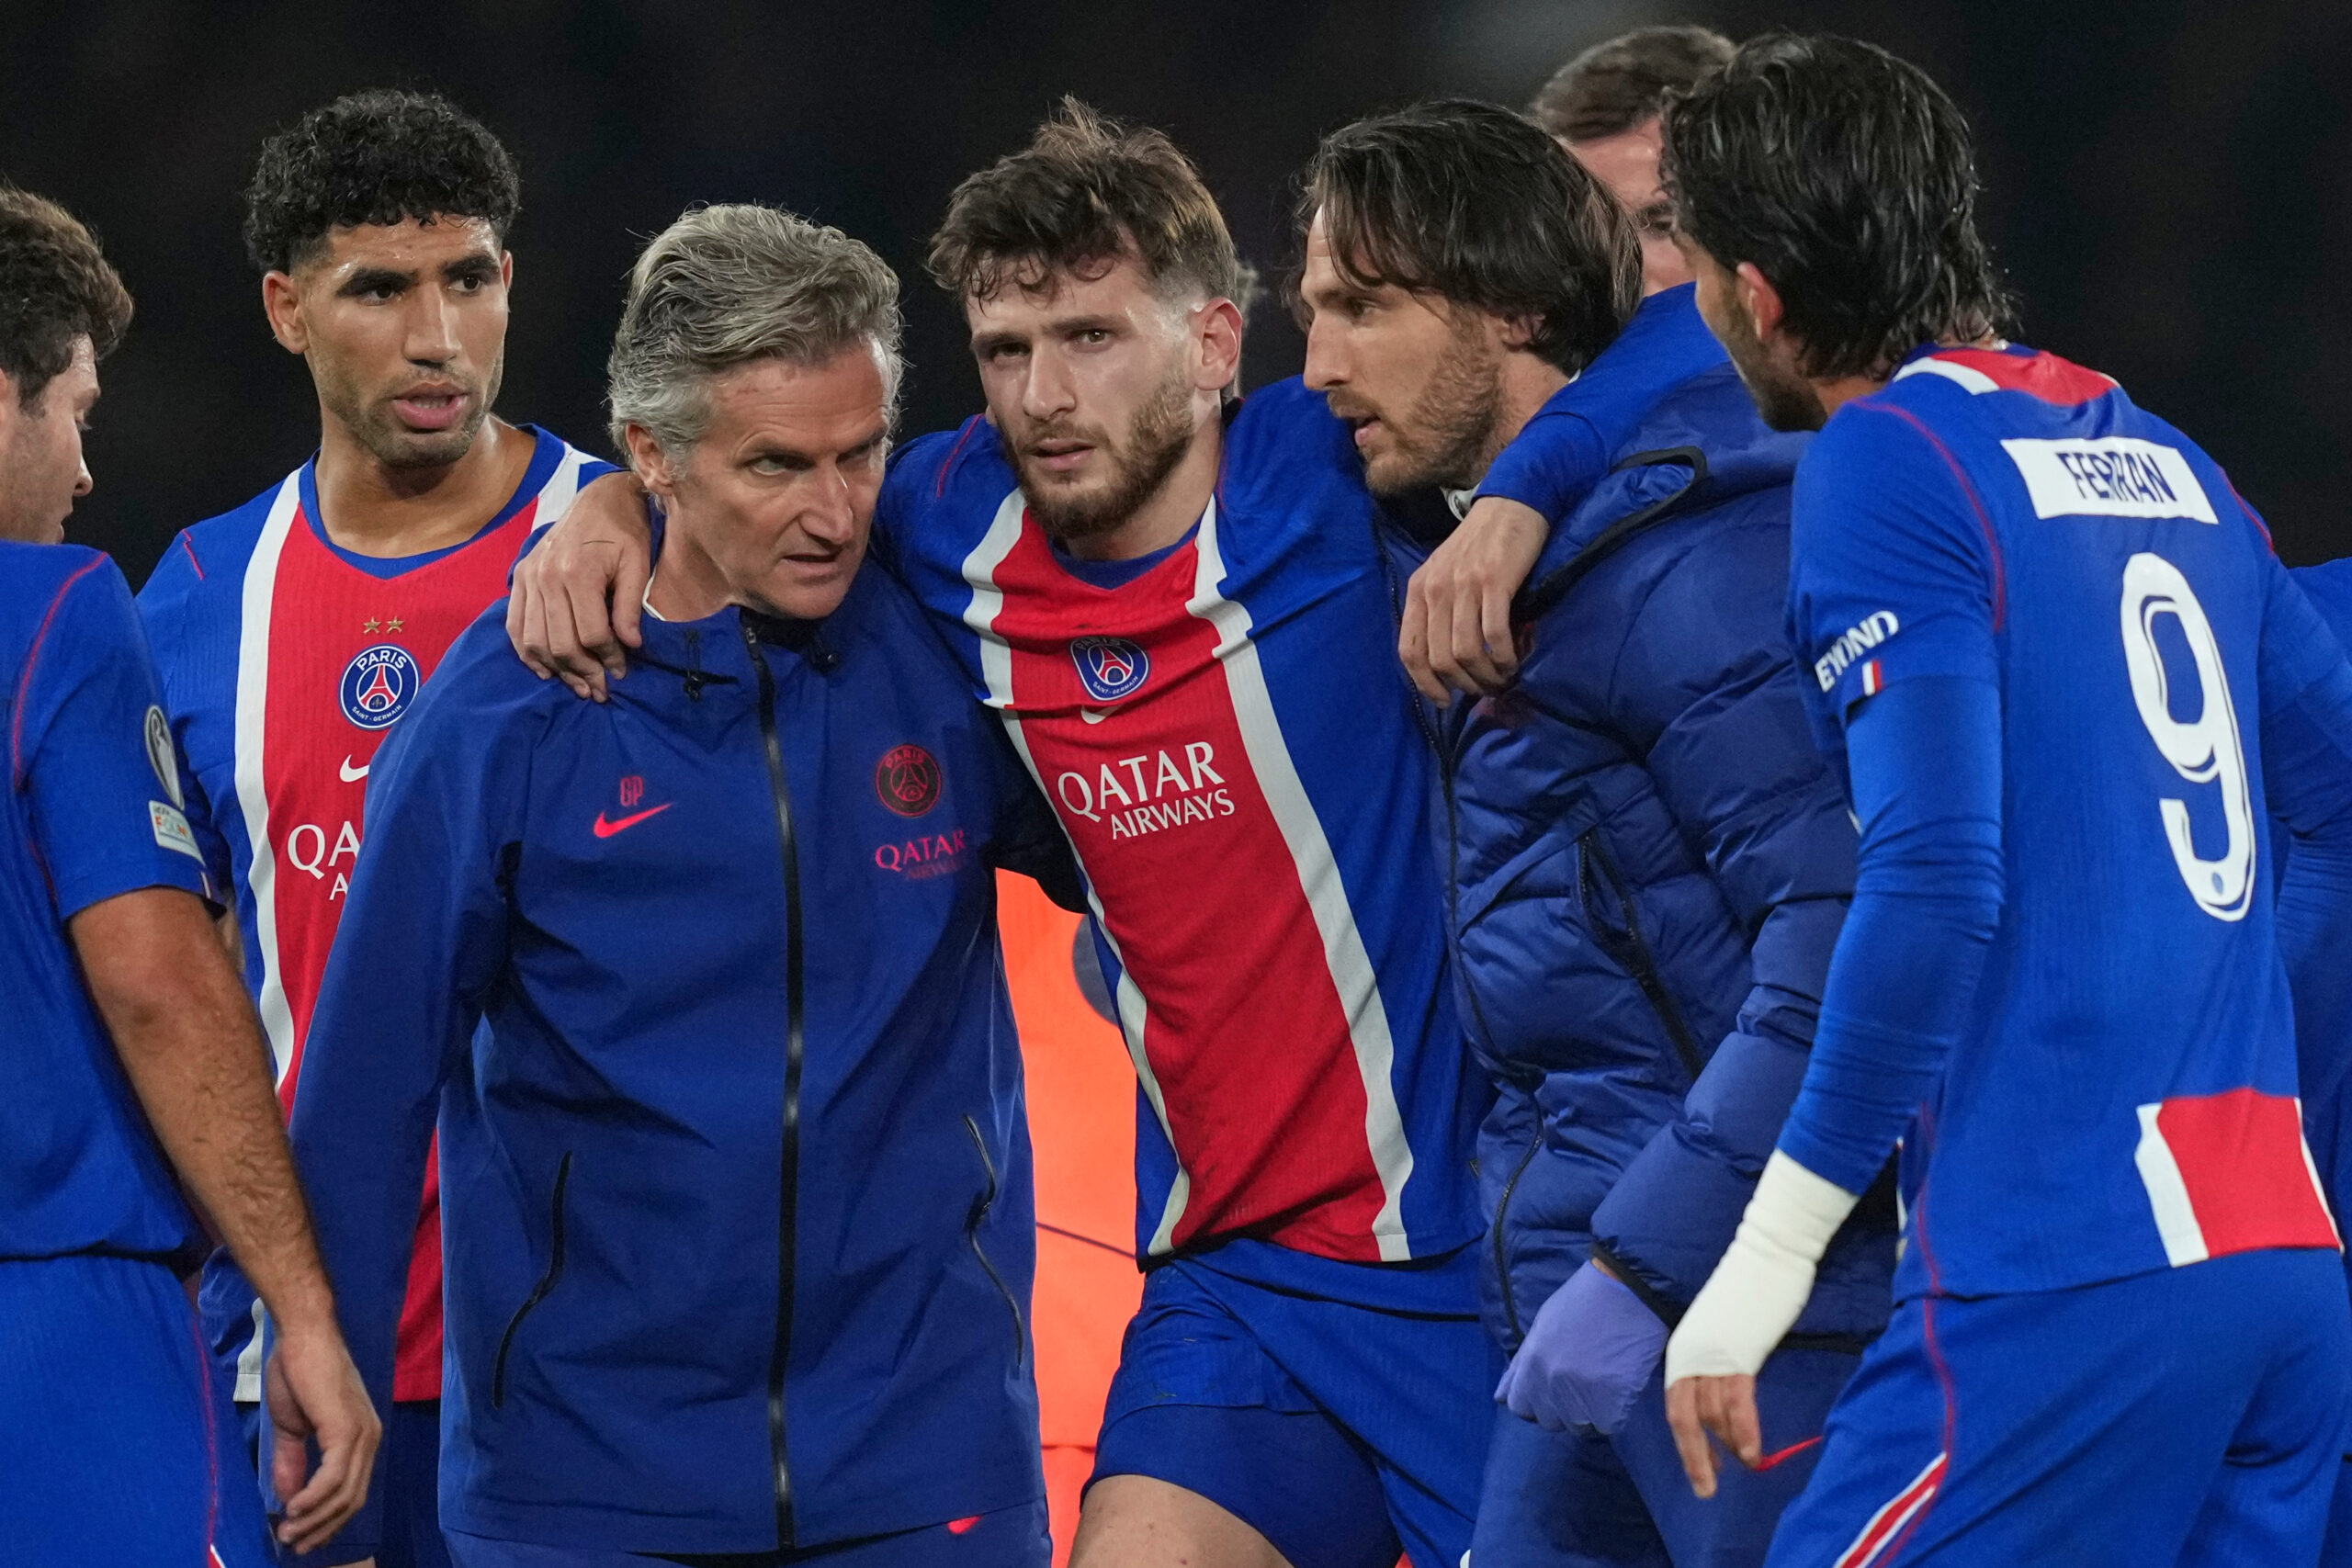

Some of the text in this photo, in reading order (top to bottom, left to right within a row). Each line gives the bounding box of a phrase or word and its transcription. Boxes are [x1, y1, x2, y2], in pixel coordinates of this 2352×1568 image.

[356, 649, 407, 671] PARIS
[2120, 552, 2256, 921] 9
[885, 749, 926, 769] PARIS
[619, 775, 645, 807] GP
[1057, 741, 1226, 823] QATAR
[1111, 788, 1236, 840] AIRWAYS
[875, 829, 966, 873] QATAR
